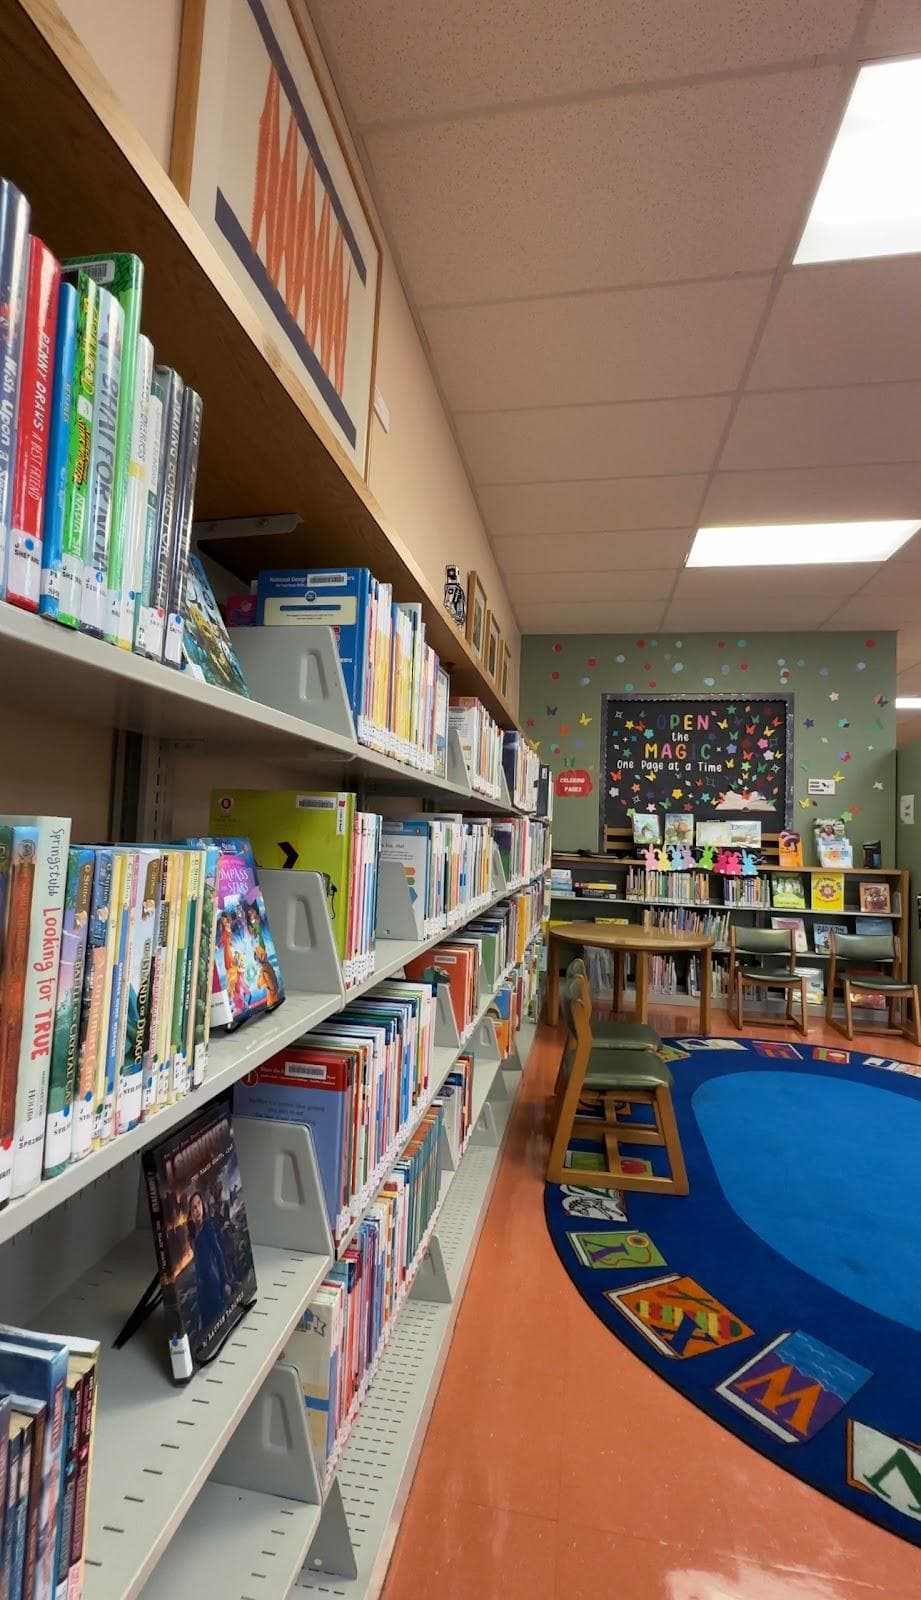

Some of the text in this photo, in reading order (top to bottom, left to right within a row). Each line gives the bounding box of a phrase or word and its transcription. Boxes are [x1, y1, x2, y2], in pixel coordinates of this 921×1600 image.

[3, 355, 17, 393] Wish
[0, 400, 14, 447] Upon
[28, 331, 50, 500] PENNY DRAWS A BEST FRIEND
[169, 401, 181, 458] MAKING
[93, 372, 119, 572] BHAI FOR NOW
[657, 714, 710, 731] OPEN
[671, 732, 690, 742] the
[617, 760, 722, 773] One Page at a Time
[644, 742, 712, 760] MAGIC
[48, 828, 65, 898] Springstubb
[219, 868, 249, 881] OMPASS
[30, 907, 60, 1062] Looking for TRUE
[73, 960, 82, 1006] BATTLE
[139, 957, 150, 1005] ISLAND
[89, 974, 103, 1051] Christmas
[66, 1024, 78, 1081] CRYSTAL
